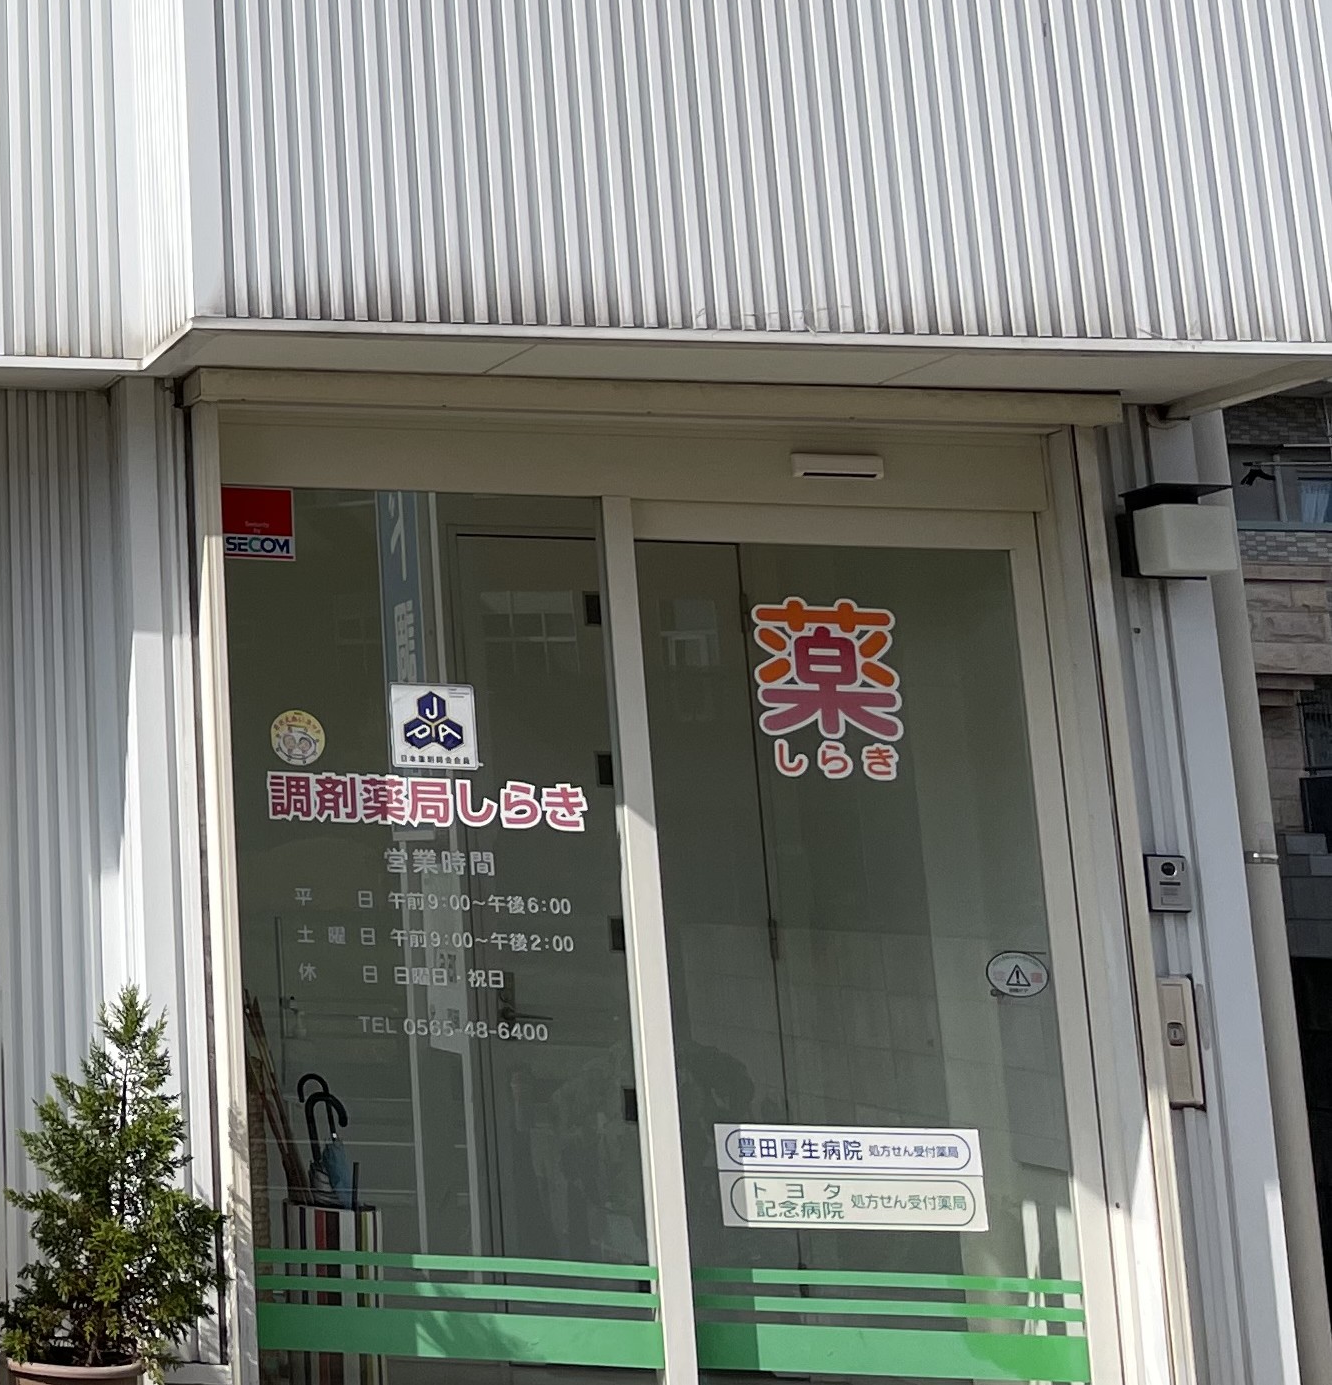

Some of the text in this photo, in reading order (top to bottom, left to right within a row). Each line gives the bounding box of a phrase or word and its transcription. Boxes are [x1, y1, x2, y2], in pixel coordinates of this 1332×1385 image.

[225, 536, 290, 554] SECOM
[751, 597, 904, 741] 薬
[775, 739, 899, 780] しらき
[268, 772, 587, 830] 調剤薬局しらき
[383, 848, 496, 877] 営業時間
[357, 1016, 549, 1042] TEL 0565-48-6400
[737, 1137, 959, 1161] 豊田厚生病院 処方せん受付薬局
[753, 1181, 842, 1201] トヨタ
[755, 1193, 968, 1220] 記念病院 処方せん受付薬局
